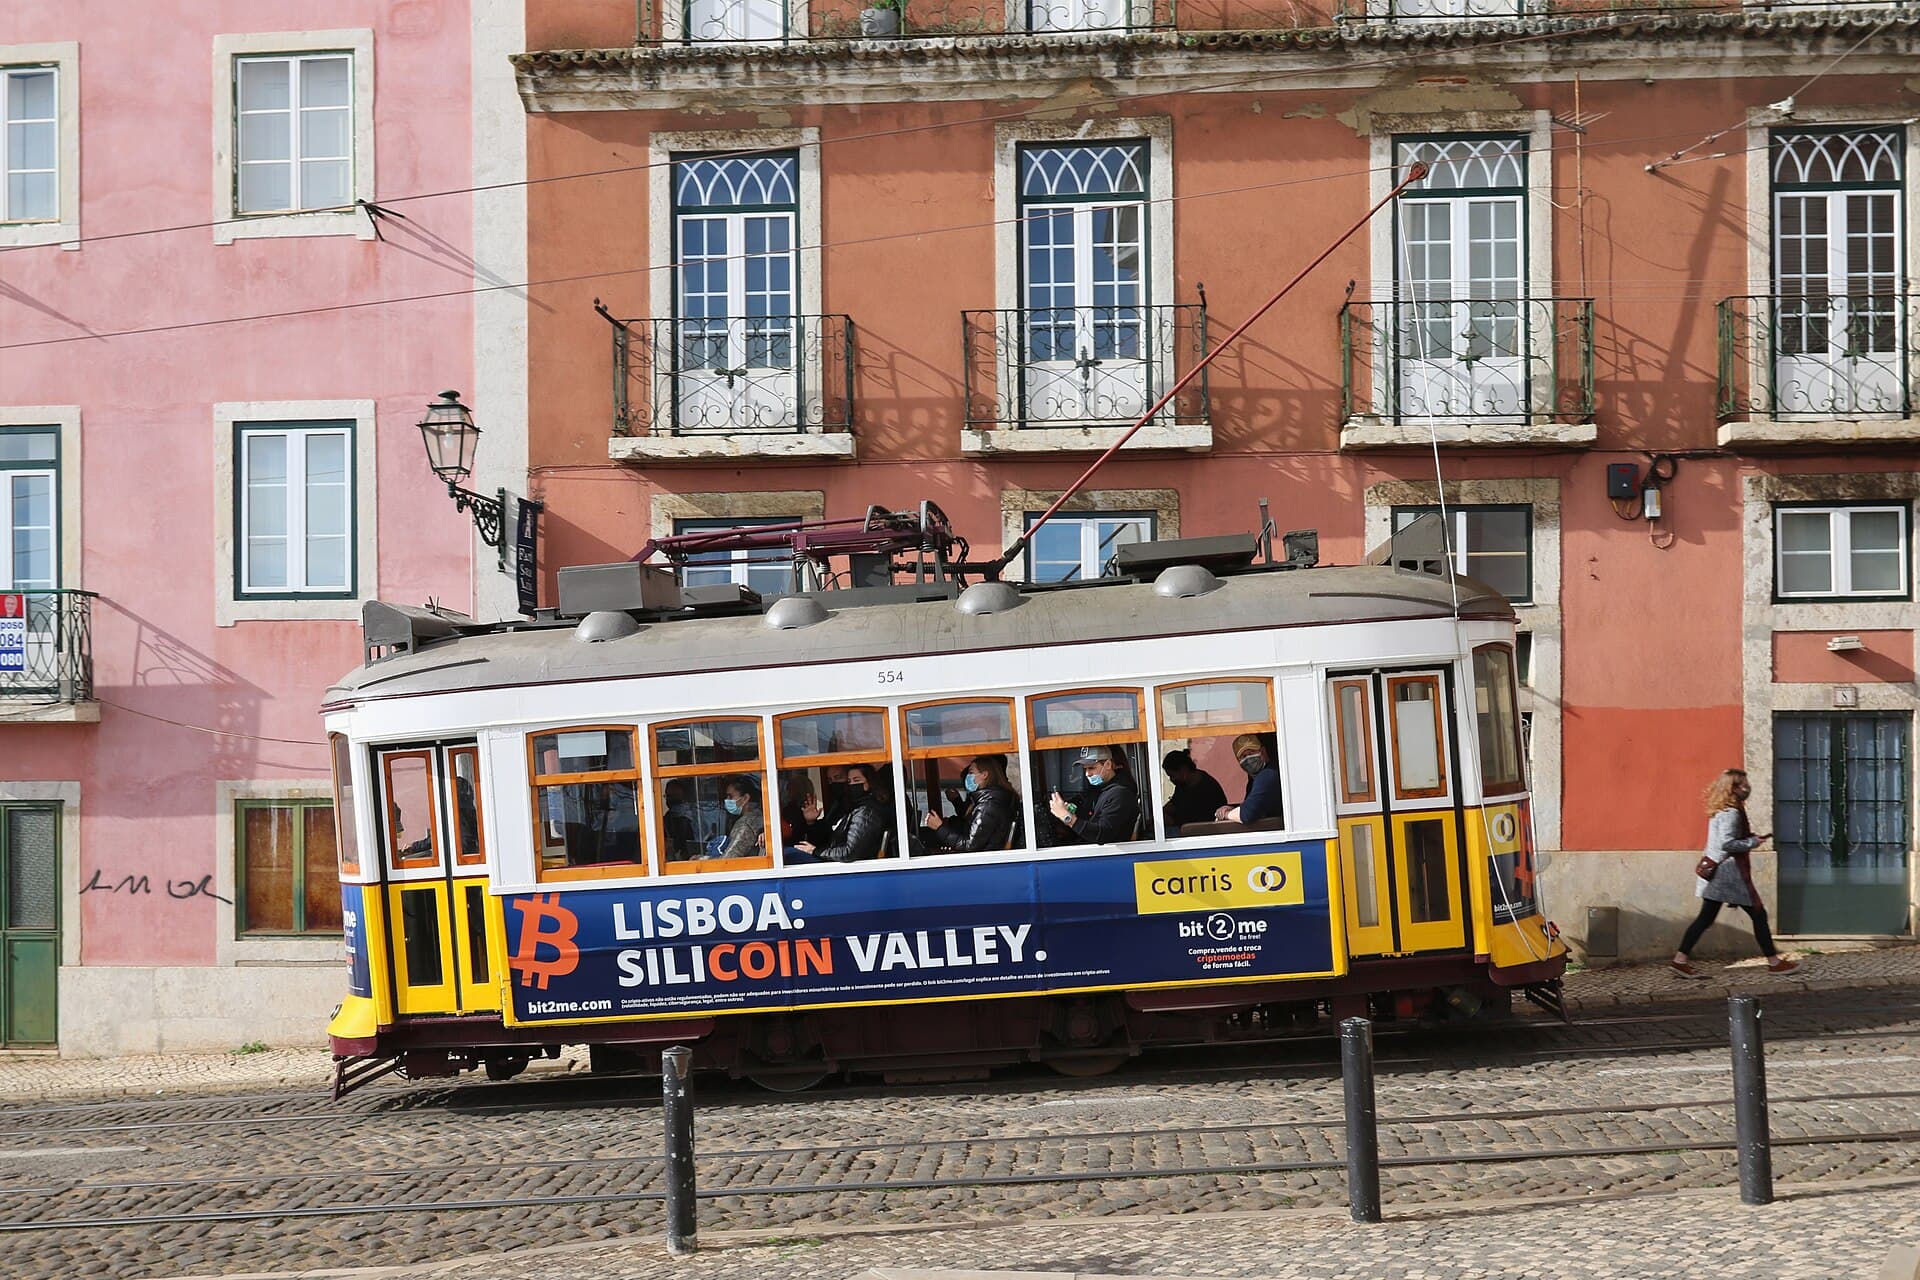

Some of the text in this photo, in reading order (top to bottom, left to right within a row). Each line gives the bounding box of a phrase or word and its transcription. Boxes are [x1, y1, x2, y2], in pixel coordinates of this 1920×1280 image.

[877, 670, 904, 684] 554
[1151, 867, 1232, 895] carris
[612, 892, 805, 941] LISBOA:
[1178, 920, 1205, 938] bit
[1237, 919, 1268, 934] me
[616, 923, 1047, 987] SILICOIN VALLEY.
[1196, 952, 1256, 963] criptomoedas
[1202, 962, 1212, 970] de
[1212, 961, 1233, 969] forma
[528, 999, 612, 1014] bit2me.com
